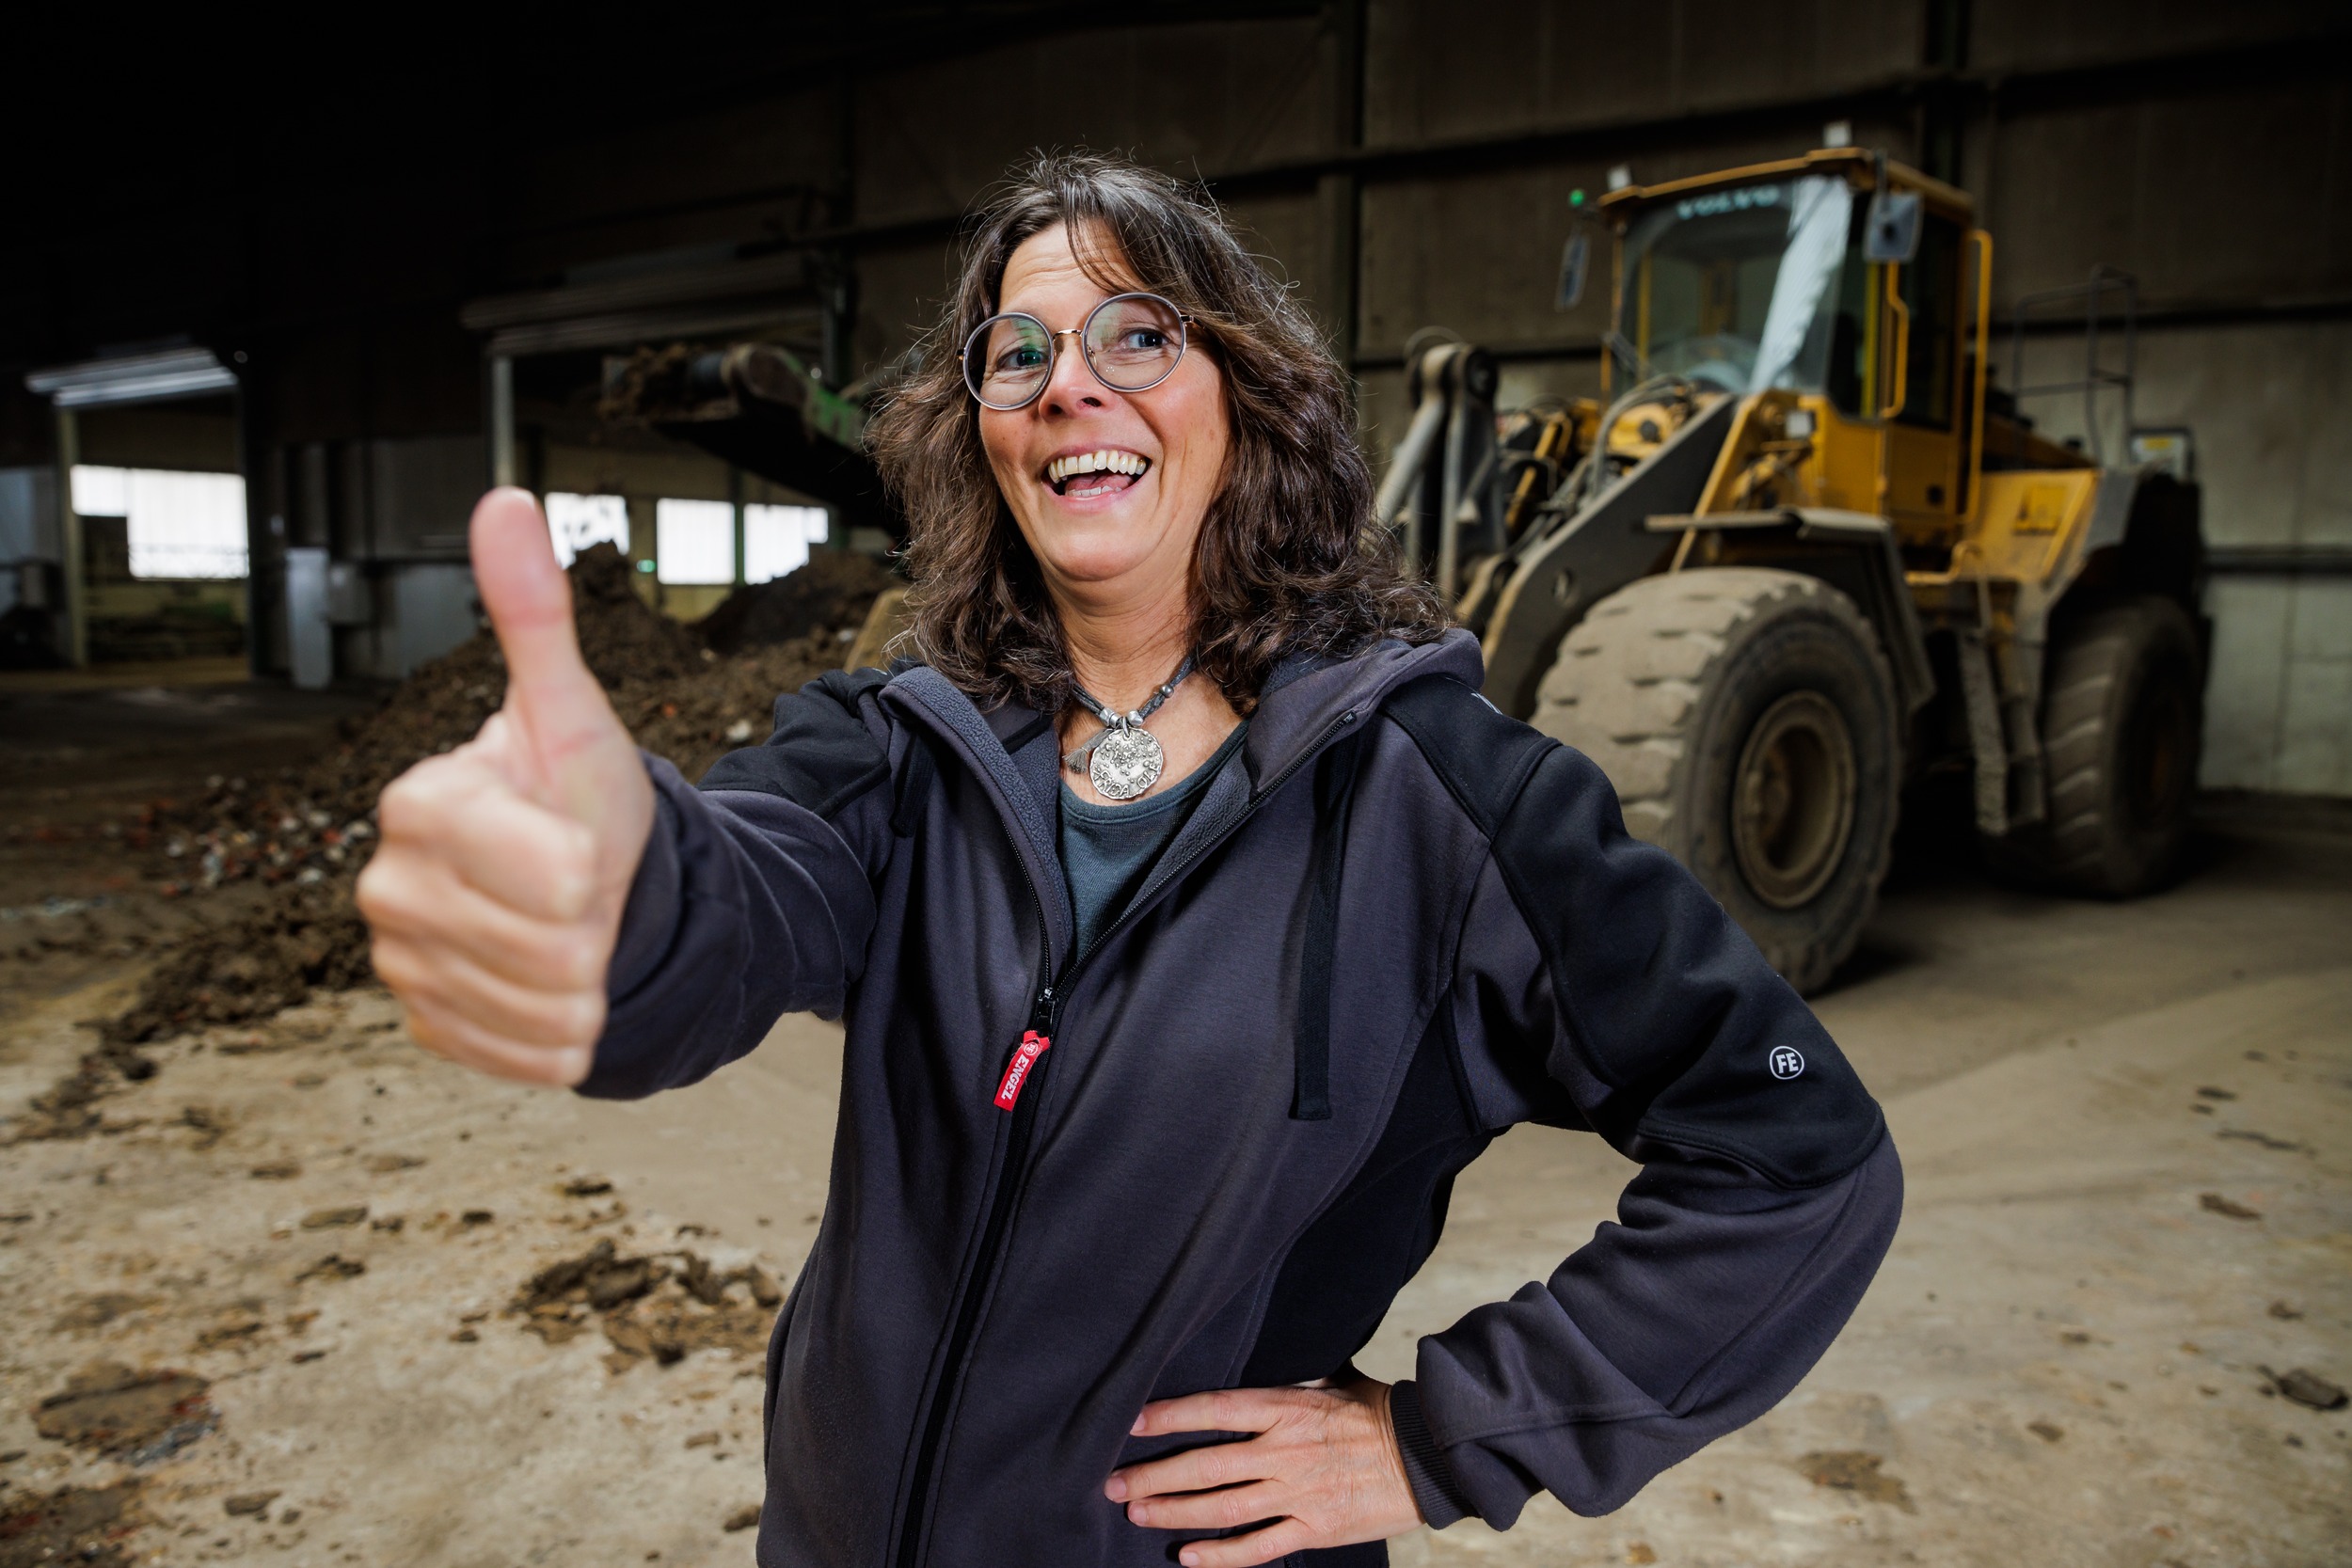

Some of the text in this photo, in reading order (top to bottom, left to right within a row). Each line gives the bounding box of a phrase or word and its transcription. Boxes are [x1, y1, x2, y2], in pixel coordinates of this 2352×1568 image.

[1677, 184, 1780, 220] VOLVO
[1001, 1053, 1030, 1101] ENGEL
[1774, 1051, 1800, 1075] FE
